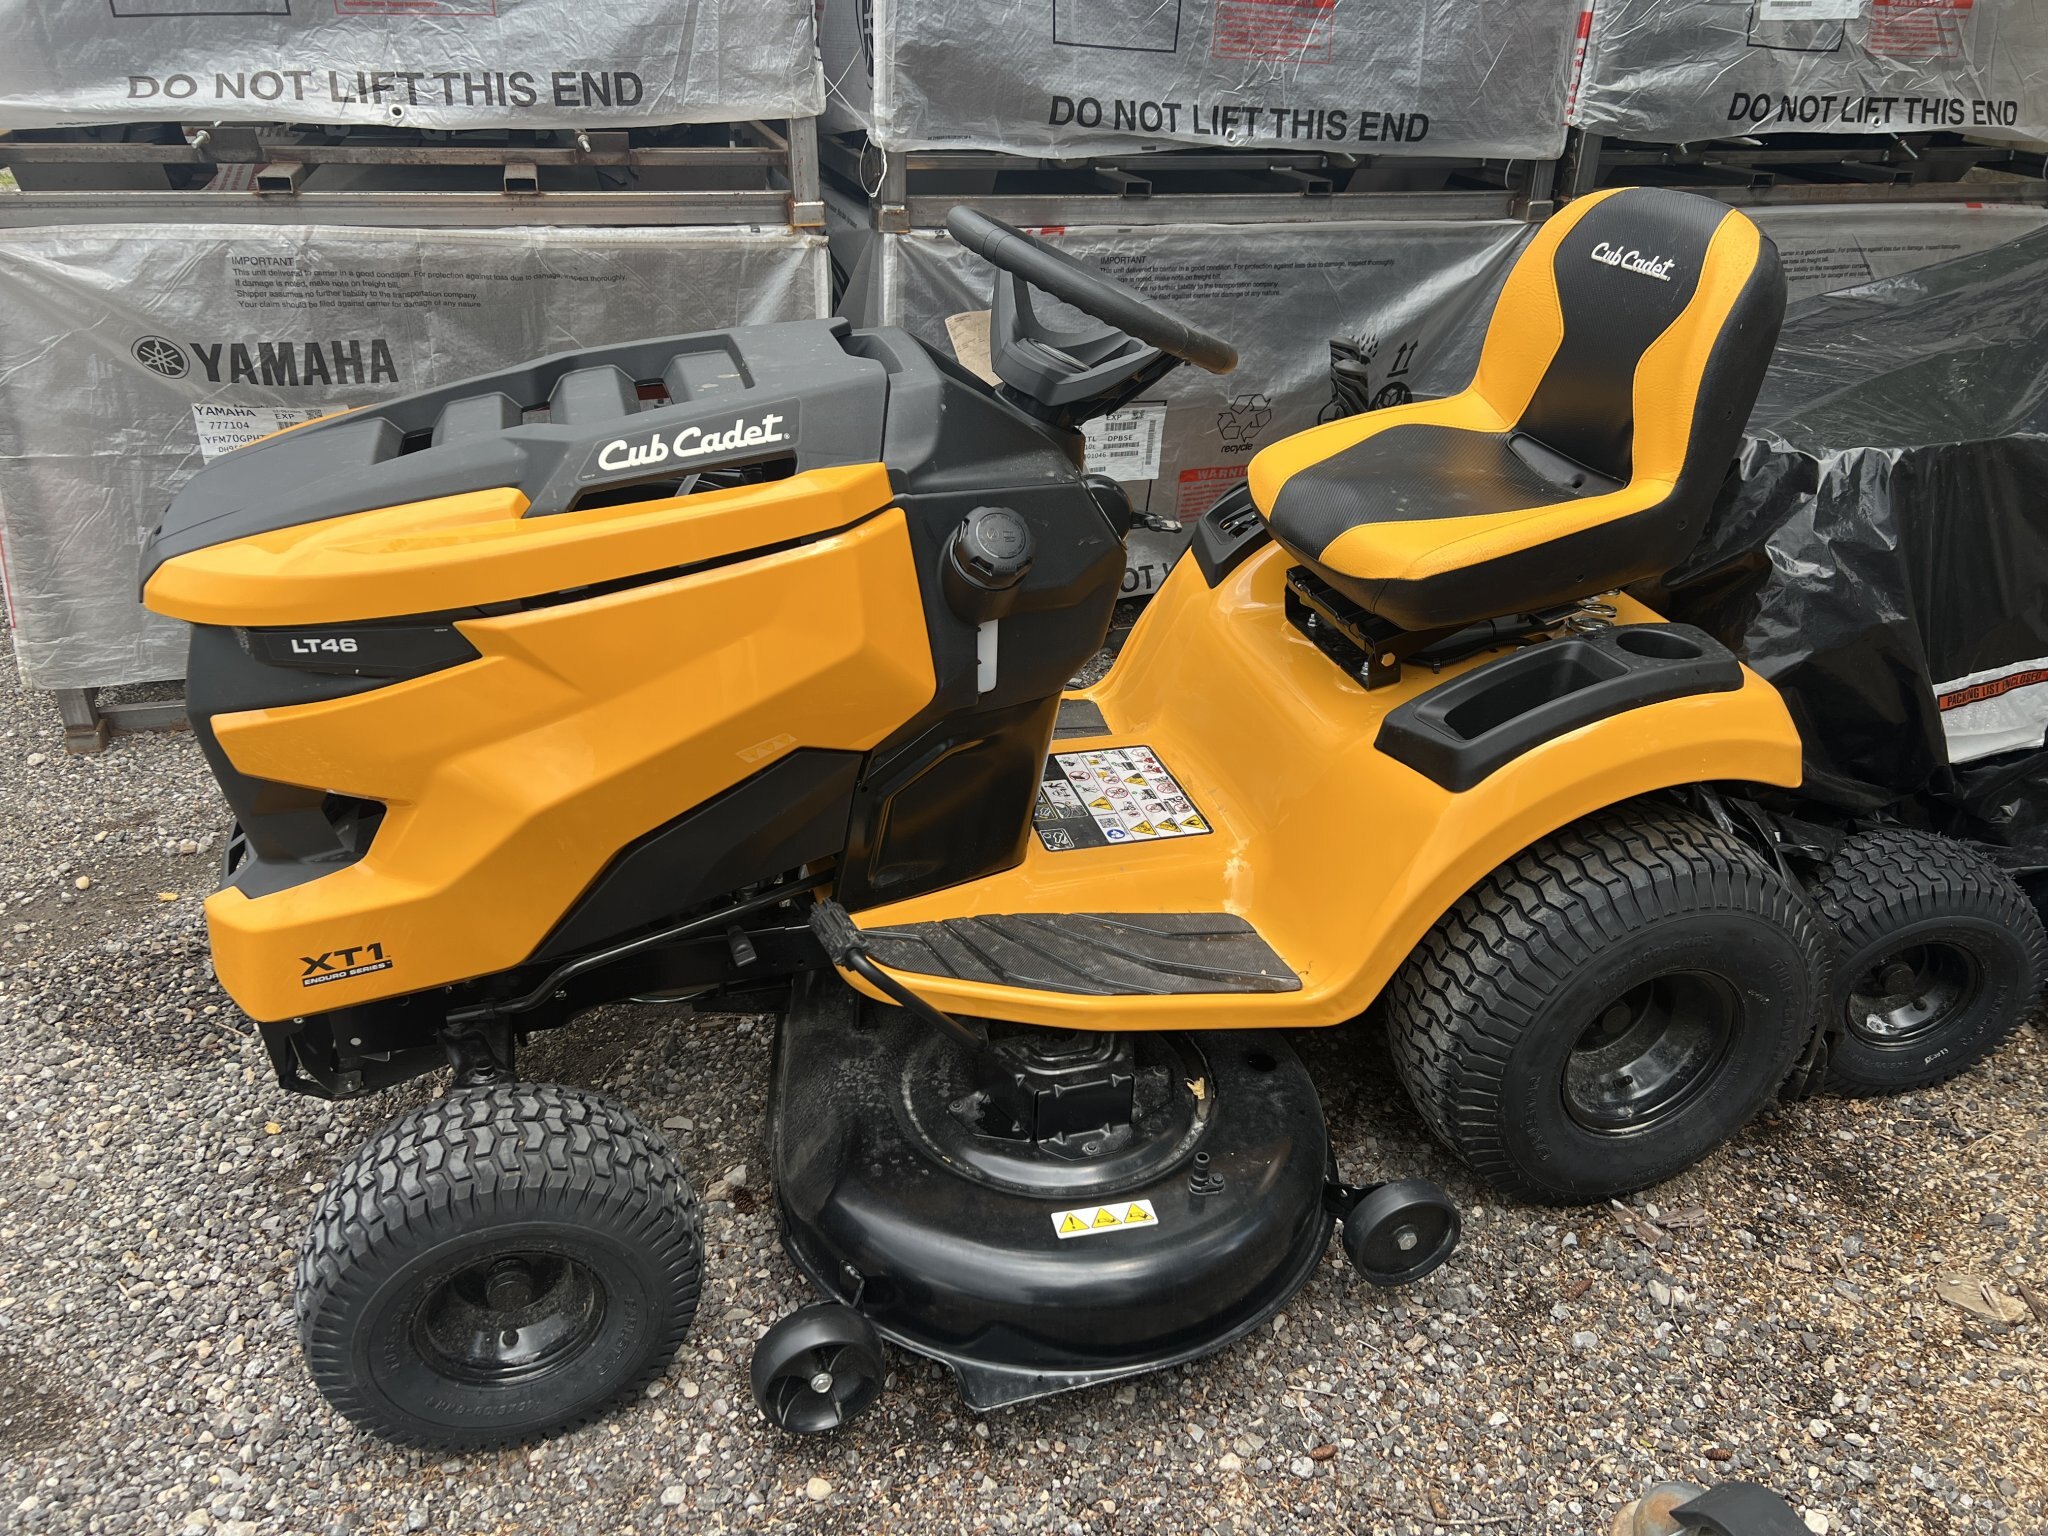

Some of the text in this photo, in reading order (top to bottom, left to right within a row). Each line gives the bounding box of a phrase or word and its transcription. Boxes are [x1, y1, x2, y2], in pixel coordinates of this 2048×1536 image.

[127, 70, 644, 108] DO NOT LIFT THIS END
[1048, 95, 1430, 143] DO NOT LIFT THIS END
[1727, 91, 2018, 126] DO NOT LIFT THIS END
[231, 256, 295, 267] IMPORTANT
[1101, 255, 1147, 265] IMPORTANT
[1590, 242, 1676, 281] Cub Cadet
[232, 268, 250, 277] This
[251, 268, 266, 277] unit
[268, 268, 302, 278] delivered
[303, 268, 312, 277] to
[313, 270, 338, 278] carrier
[356, 271, 375, 279] good
[427, 272, 464, 280] protection
[465, 273, 493, 281] against
[510, 274, 524, 282] due
[189, 338, 399, 387] YAMAHA
[194, 405, 257, 417] YAMAHA
[274, 412, 295, 420] EXP
[209, 420, 250, 430] 777104
[598, 413, 784, 471] Cub Cadet
[1220, 442, 1254, 455] recycle
[1120, 564, 1155, 593] OT
[291, 637, 359, 654] LT46
[1946, 671, 2043, 707] PACKING LIST ENCLOSED
[298, 942, 384, 977] XT1
[304, 962, 386, 986] ENDURO SERIES
